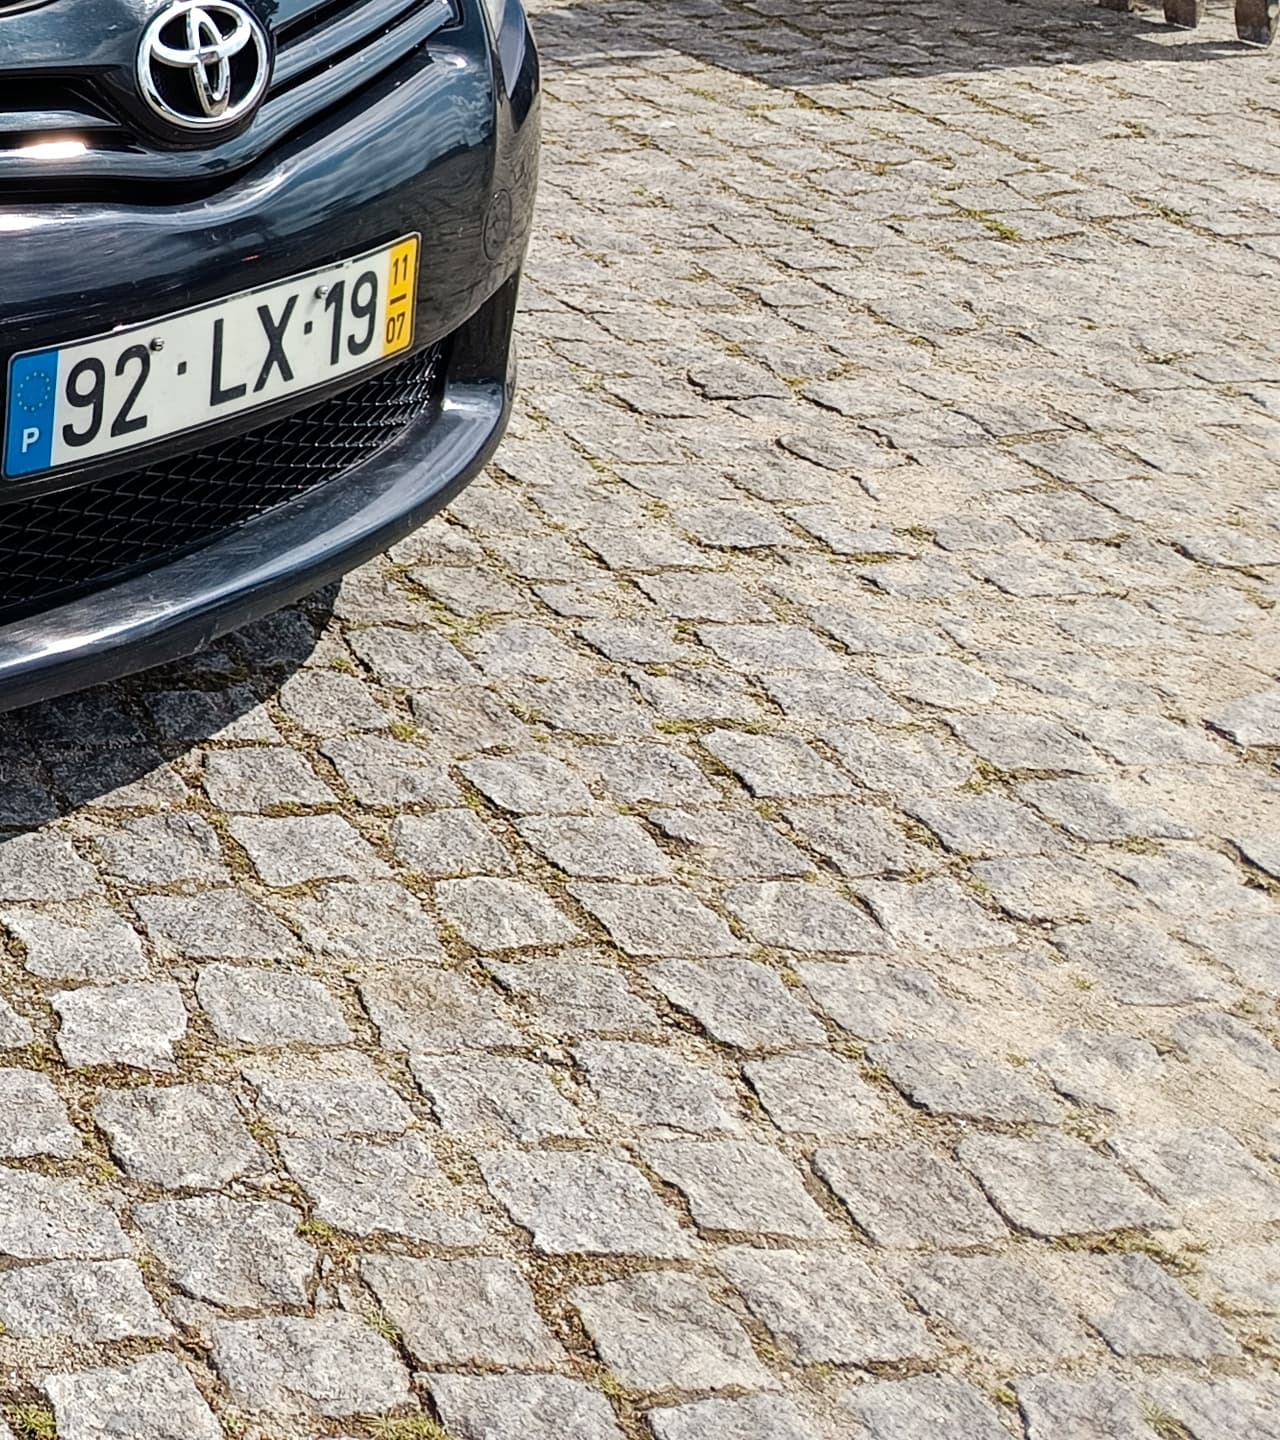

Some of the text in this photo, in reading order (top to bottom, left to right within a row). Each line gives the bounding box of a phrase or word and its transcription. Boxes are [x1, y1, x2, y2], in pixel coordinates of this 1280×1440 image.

[393, 254, 408, 285] 11
[386, 312, 405, 344] 07
[21, 428, 40, 453] P
